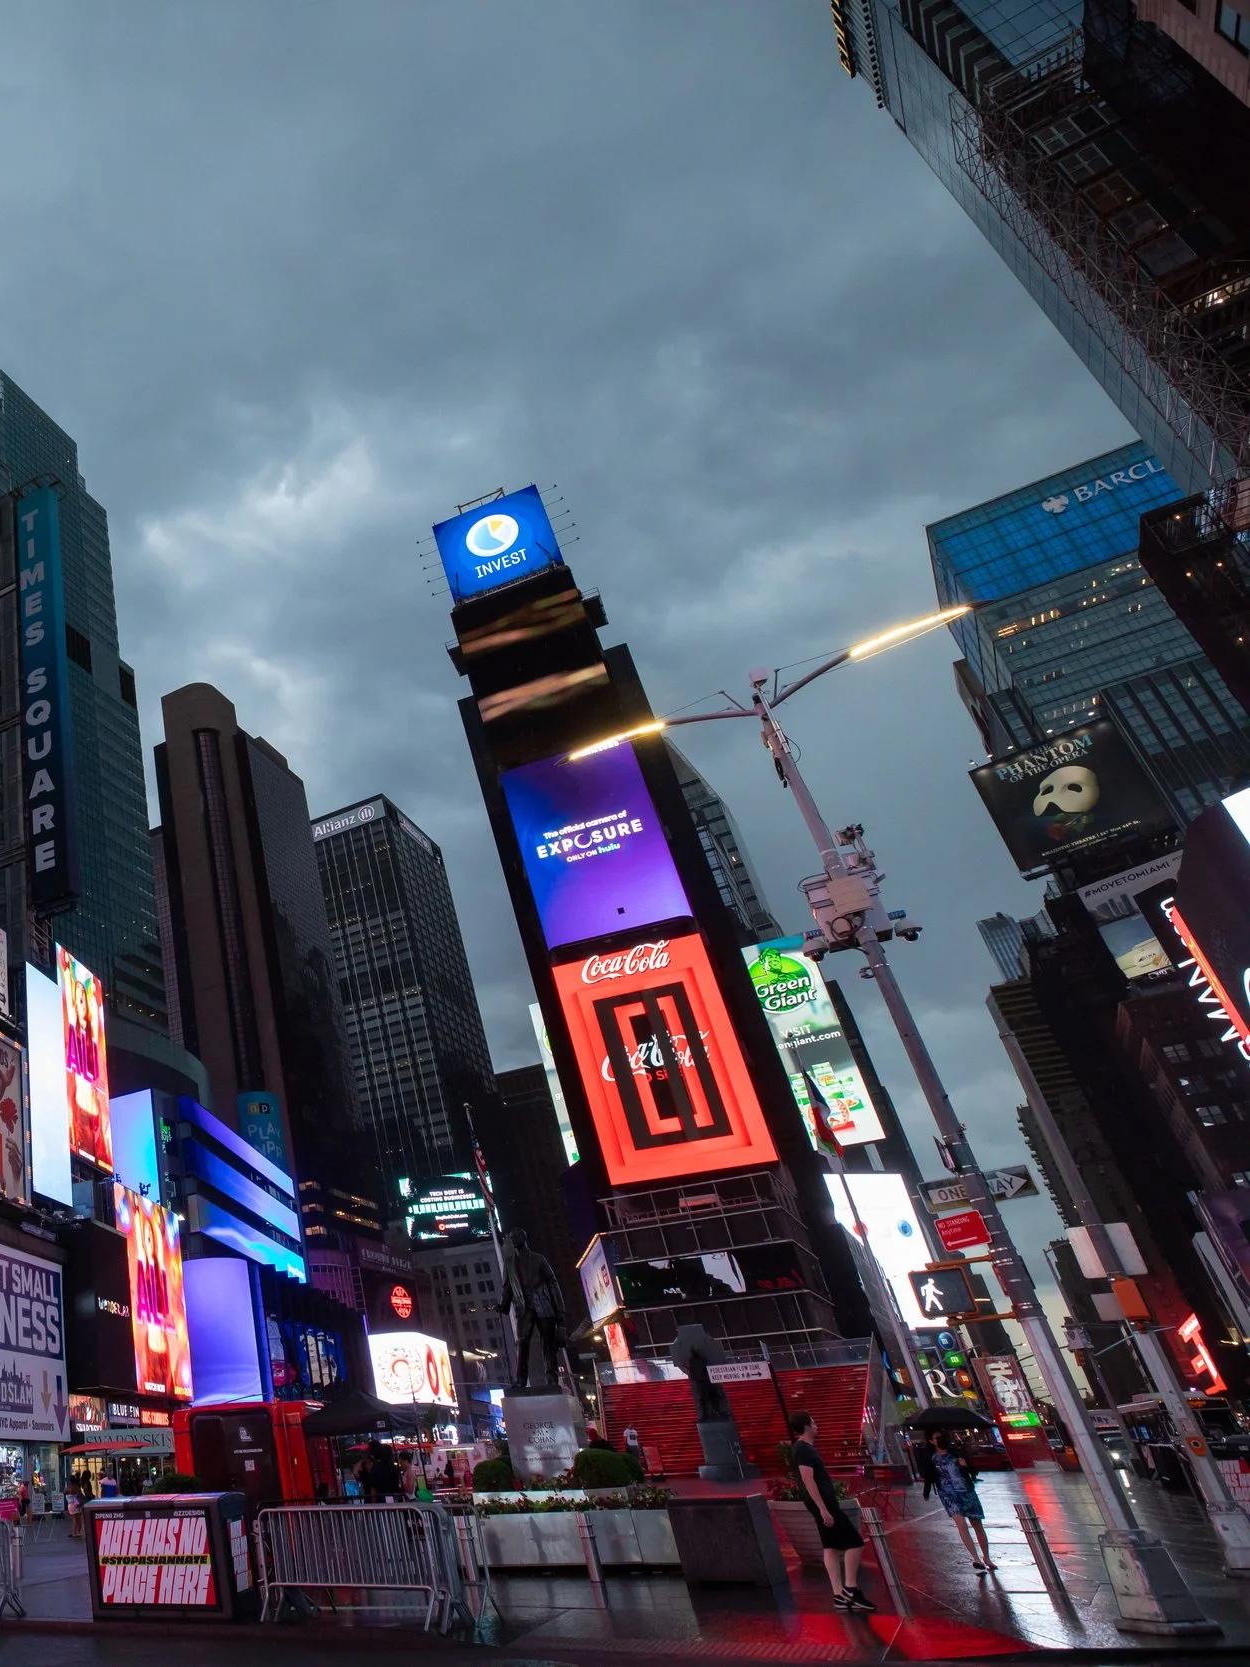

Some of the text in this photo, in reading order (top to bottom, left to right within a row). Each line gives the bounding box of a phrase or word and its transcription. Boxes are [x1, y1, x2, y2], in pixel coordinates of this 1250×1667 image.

[1073, 460, 1165, 503] BARCL
[475, 548, 528, 579] INVEST
[20, 508, 57, 873] TIMES SQUARE
[996, 735, 1094, 781] PHANTOM
[1009, 750, 1090, 784] OF THE OPERA
[314, 815, 356, 838] Allianz
[543, 830, 558, 840] The
[616, 809, 628, 820] of
[536, 818, 644, 859] EXPOSURE
[566, 841, 621, 863] ONLY ON hulu
[1084, 862, 1172, 898] #MOVETOMIAMI
[581, 939, 670, 984] Coca-Cola
[756, 976, 811, 998] Green
[765, 988, 817, 1011] Giant
[247, 1122, 282, 1141] PLAY
[937, 1184, 966, 1202] ONE
[941, 1227, 962, 1237] Anytime
[947, 1216, 970, 1228] STANDING
[12, 1263, 58, 1304] SMALL
[710, 1366, 736, 1374] PEDESTRIAN
[7, 1383, 34, 1406] SLAM
[113, 1404, 128, 1417] BLUE
[9, 1418, 28, 1431] Apparel
[32, 1420, 54, 1432] Souvenirs
[523, 1422, 555, 1430] GEORGE
[99, 1519, 142, 1556] HATE
[140, 1518, 180, 1556] HAS
[178, 1517, 207, 1555] NO
[101, 1555, 208, 1565] #STOPASIANHATE
[103, 1565, 210, 1605] PLACE HERE
